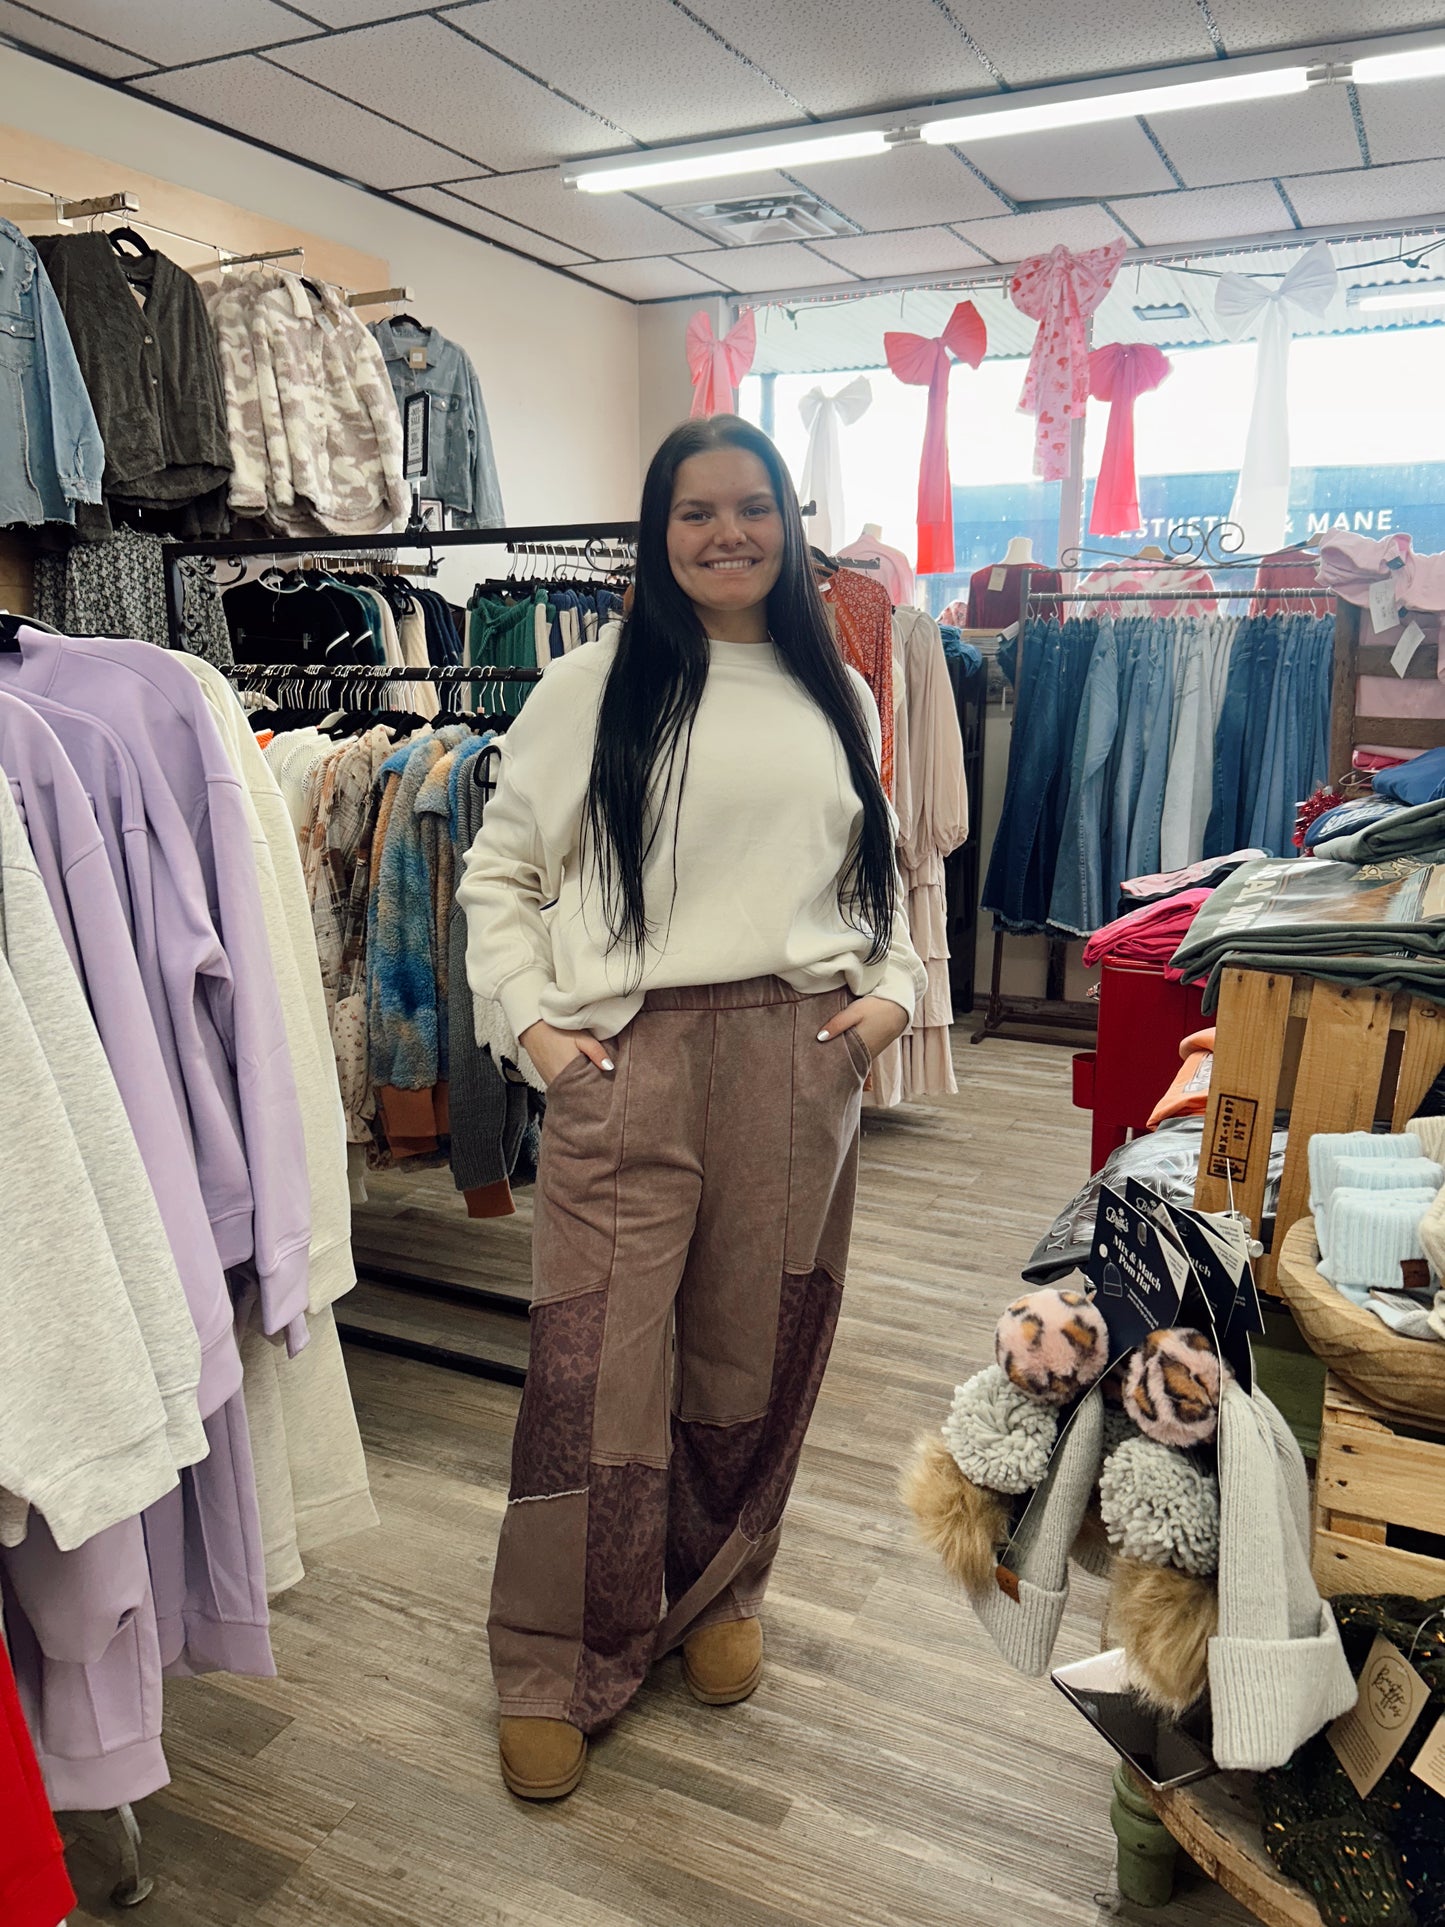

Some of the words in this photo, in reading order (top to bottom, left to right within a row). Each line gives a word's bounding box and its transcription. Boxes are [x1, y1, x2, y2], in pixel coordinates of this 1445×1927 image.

[1098, 515, 1227, 539] STHETI
[1307, 509, 1393, 533] MANE
[1233, 1118, 1247, 1140] HT
[1113, 1235, 1129, 1257] Mix
[1129, 1251, 1137, 1265] &
[1136, 1258, 1161, 1292] Match
[1118, 1254, 1136, 1279] Pom
[1136, 1272, 1151, 1295] Hat
[1190, 1256, 1212, 1278] atch
